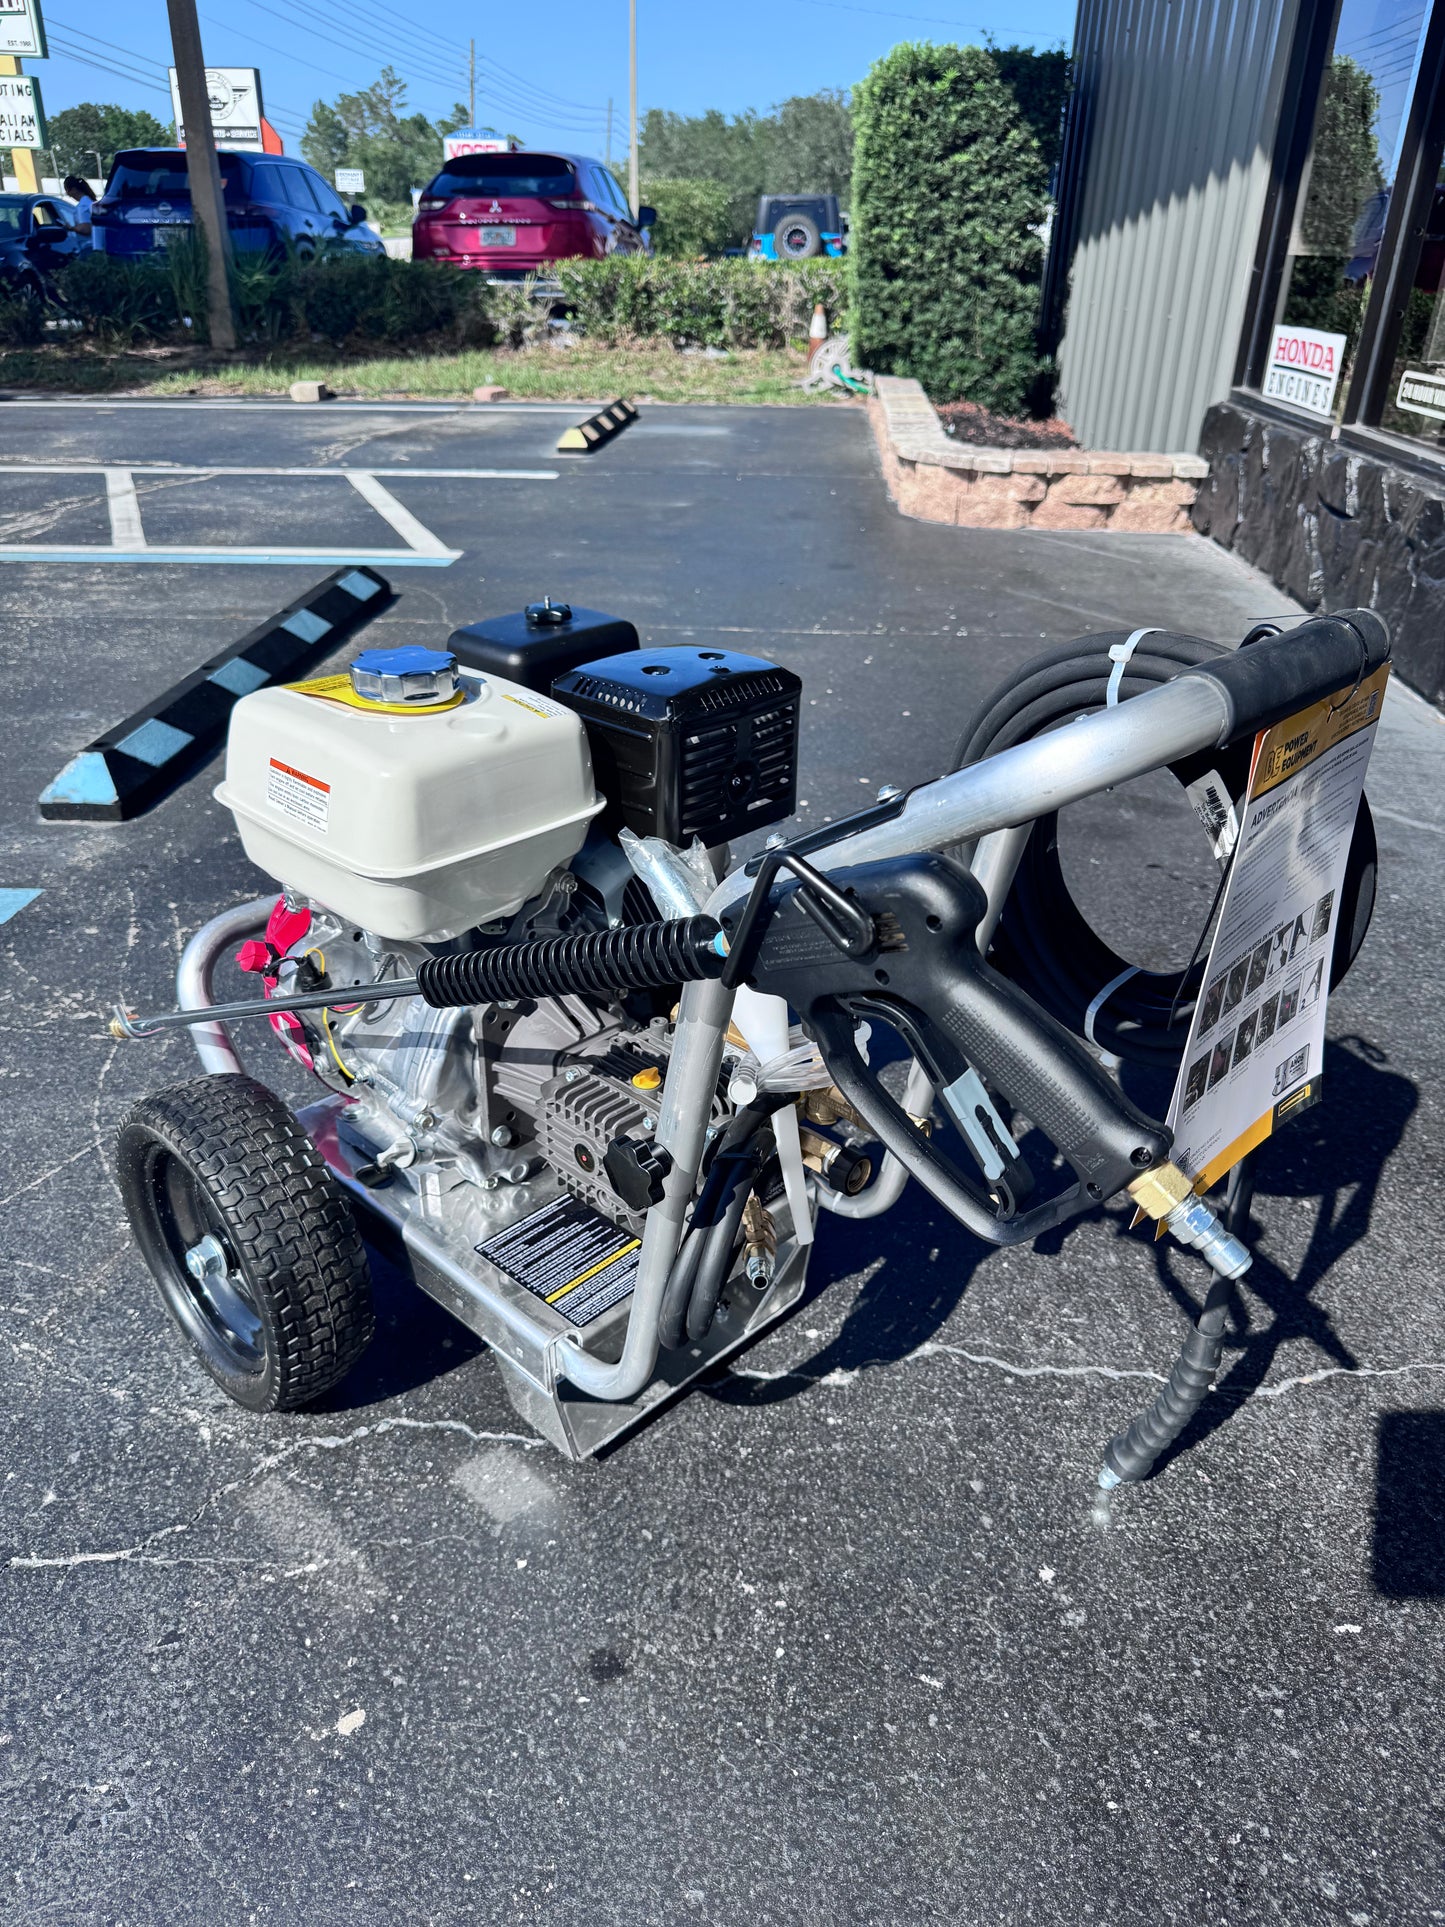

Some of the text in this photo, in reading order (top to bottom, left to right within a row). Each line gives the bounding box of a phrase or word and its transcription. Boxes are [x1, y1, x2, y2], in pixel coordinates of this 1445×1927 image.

[1275, 337, 1334, 373] HONDA
[1267, 372, 1330, 409] ENGINES
[1281, 738, 1319, 774] EQUIPMENT
[1284, 731, 1309, 756] POWER
